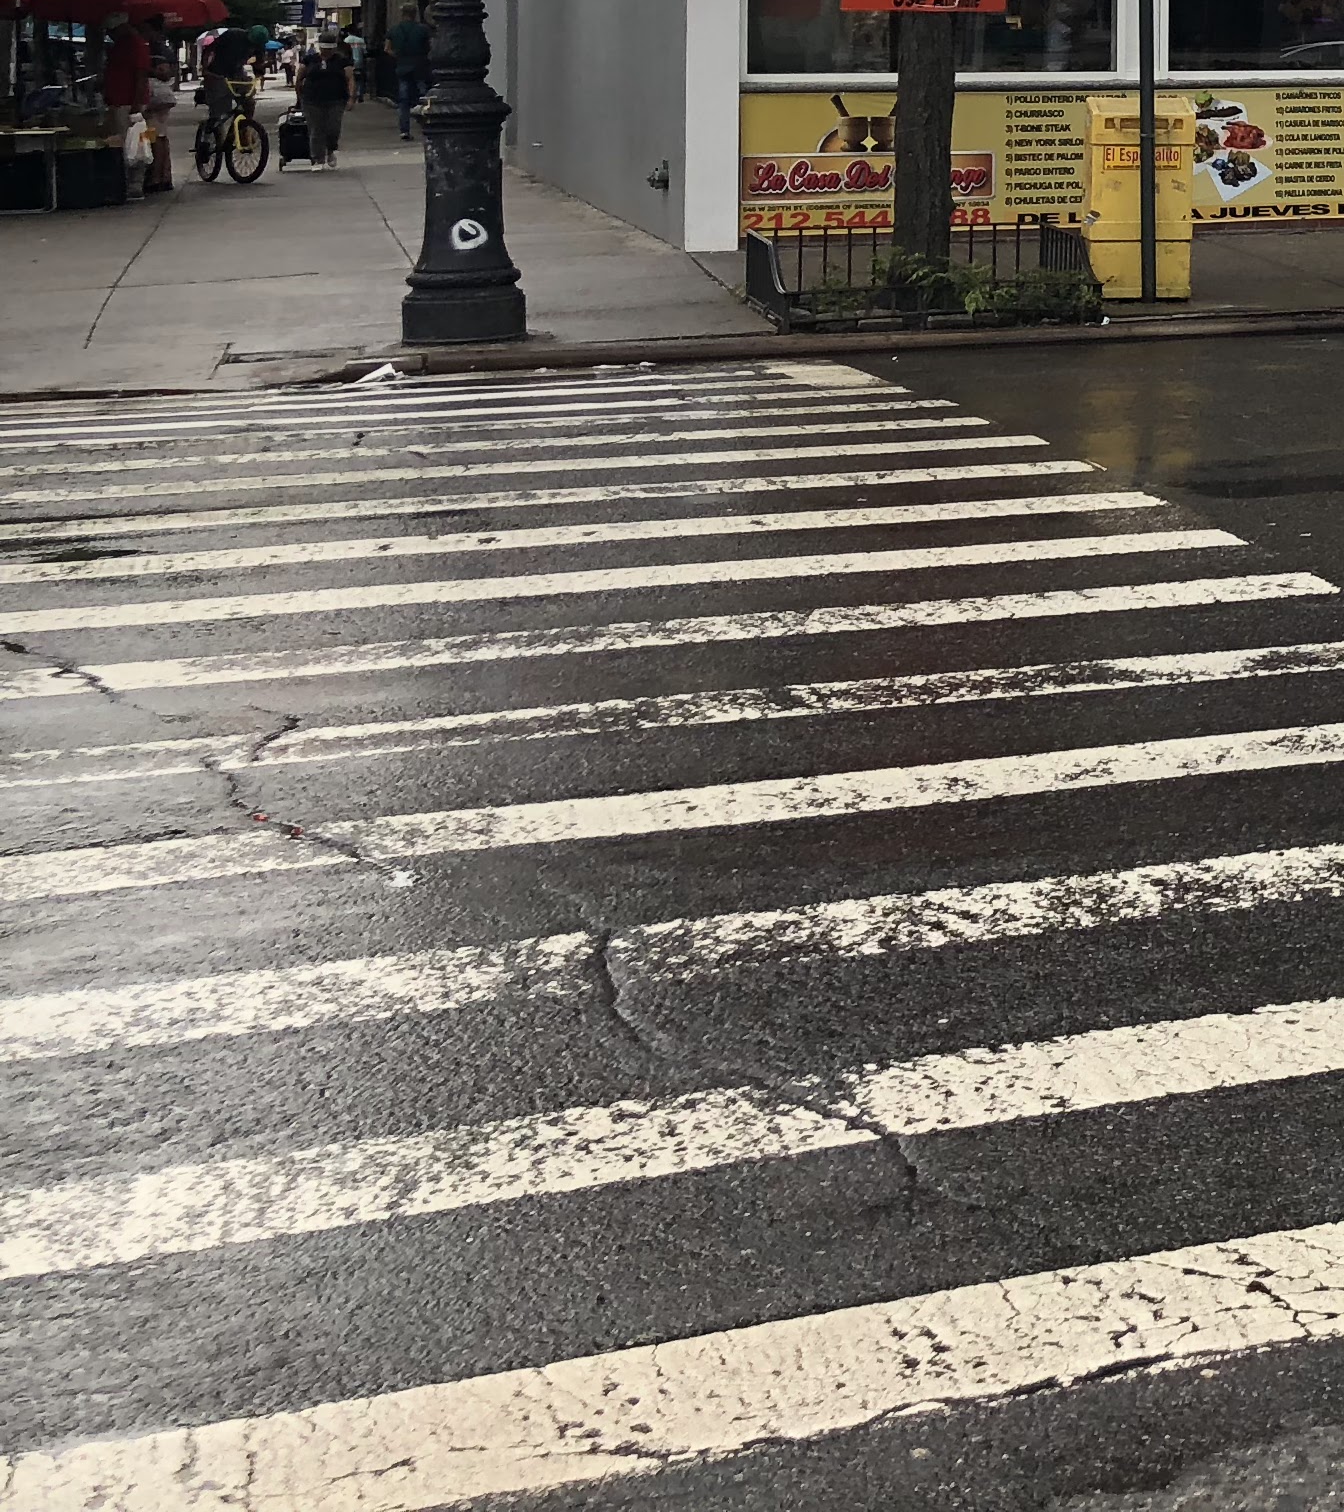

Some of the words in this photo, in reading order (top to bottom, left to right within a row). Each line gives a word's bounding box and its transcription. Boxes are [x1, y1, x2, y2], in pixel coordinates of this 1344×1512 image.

[1014, 95, 1040, 104] POLLO
[1041, 95, 1074, 104] ENTERO
[1014, 109, 1065, 118] CHURRASCO
[1044, 123, 1071, 132] STEAK
[1014, 138, 1033, 147] NEW
[1034, 138, 1057, 147] YORK
[1014, 153, 1043, 162] BISTEC
[1044, 153, 1055, 161] DE
[1105, 147, 1115, 162] El
[787, 159, 842, 192] Casa
[1014, 167, 1041, 176] PARGO
[1042, 167, 1075, 176] ENTERO
[1014, 182, 1053, 190] PECHUGA
[1054, 181, 1064, 190] DE
[1014, 196, 1056, 205] CHULETAS
[1057, 196, 1068, 204] DE
[1209, 203, 1331, 219] JUEVES
